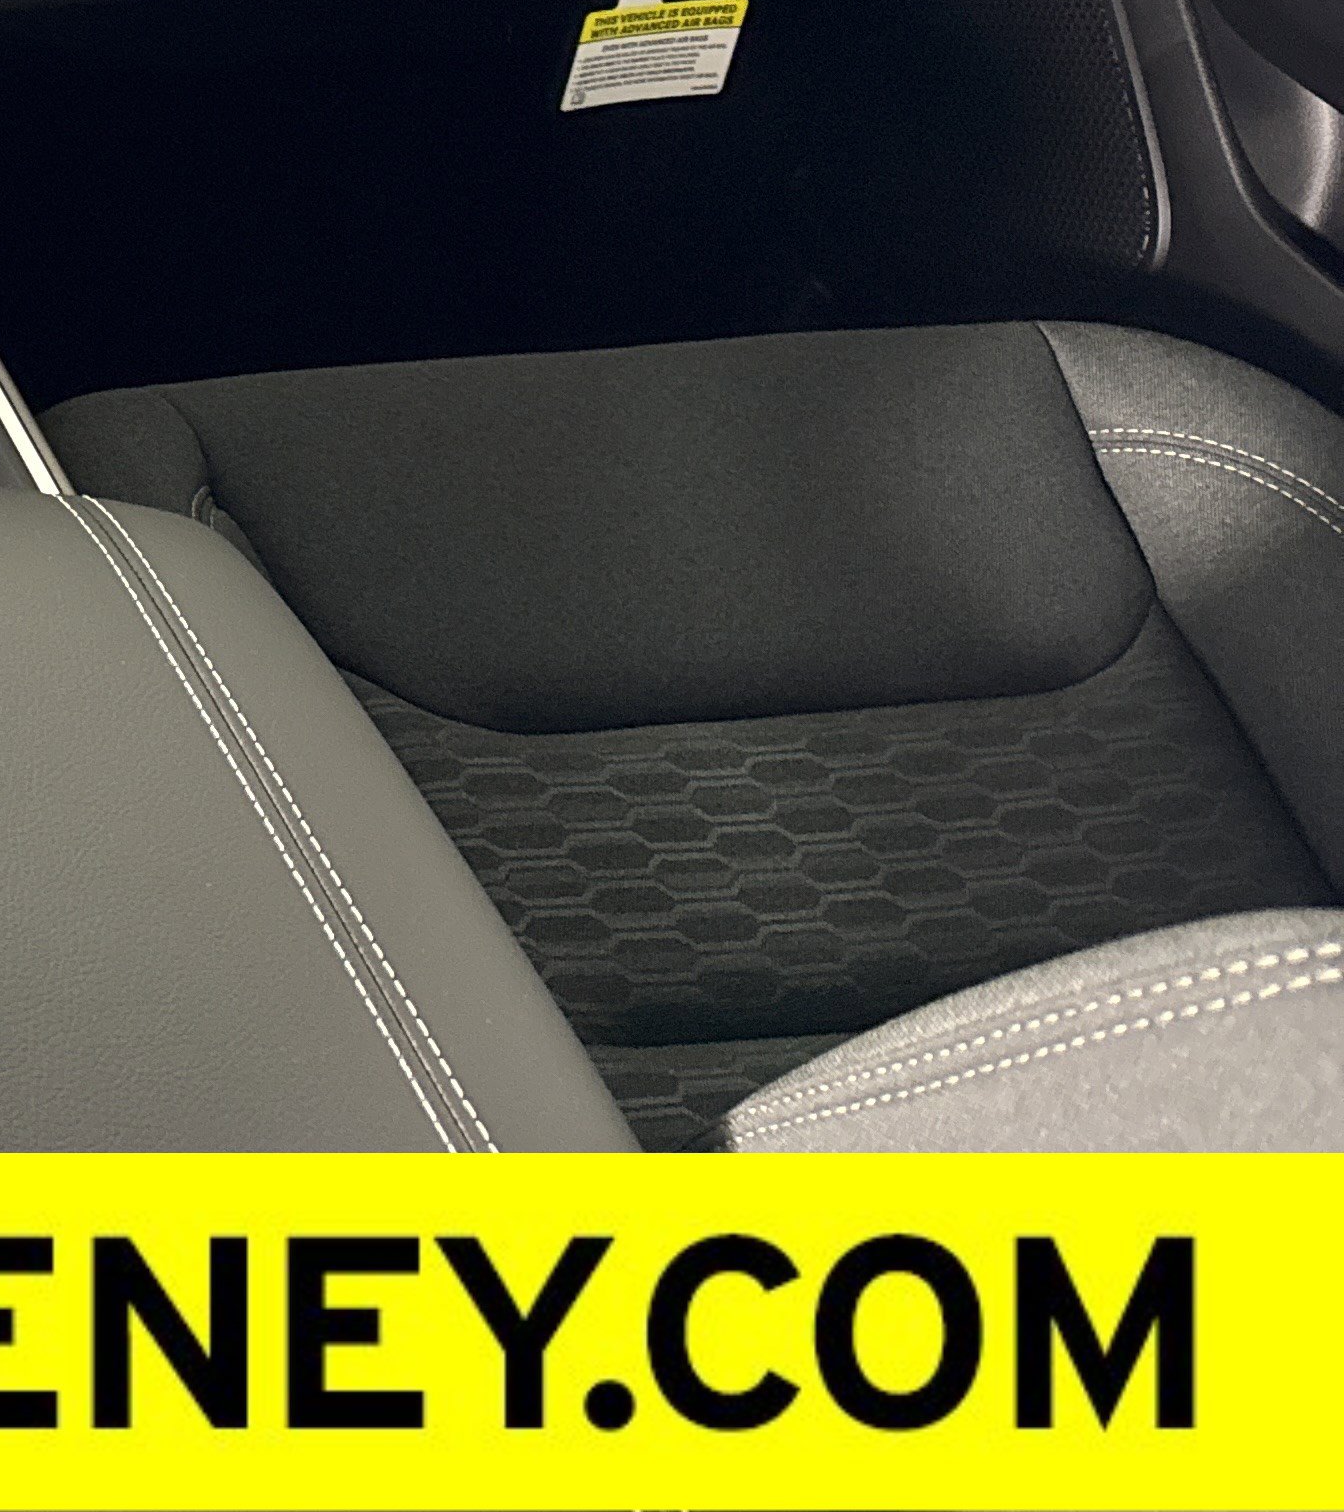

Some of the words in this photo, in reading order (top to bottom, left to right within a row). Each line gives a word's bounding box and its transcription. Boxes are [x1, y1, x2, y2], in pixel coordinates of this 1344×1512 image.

[621, 9, 664, 23] VEHICLE
[667, 8, 679, 18] IS
[681, 3, 738, 17] EQUIPPED
[620, 19, 680, 34] ADVANCED
[682, 17, 701, 27] AIR
[703, 15, 734, 26] BAGS
